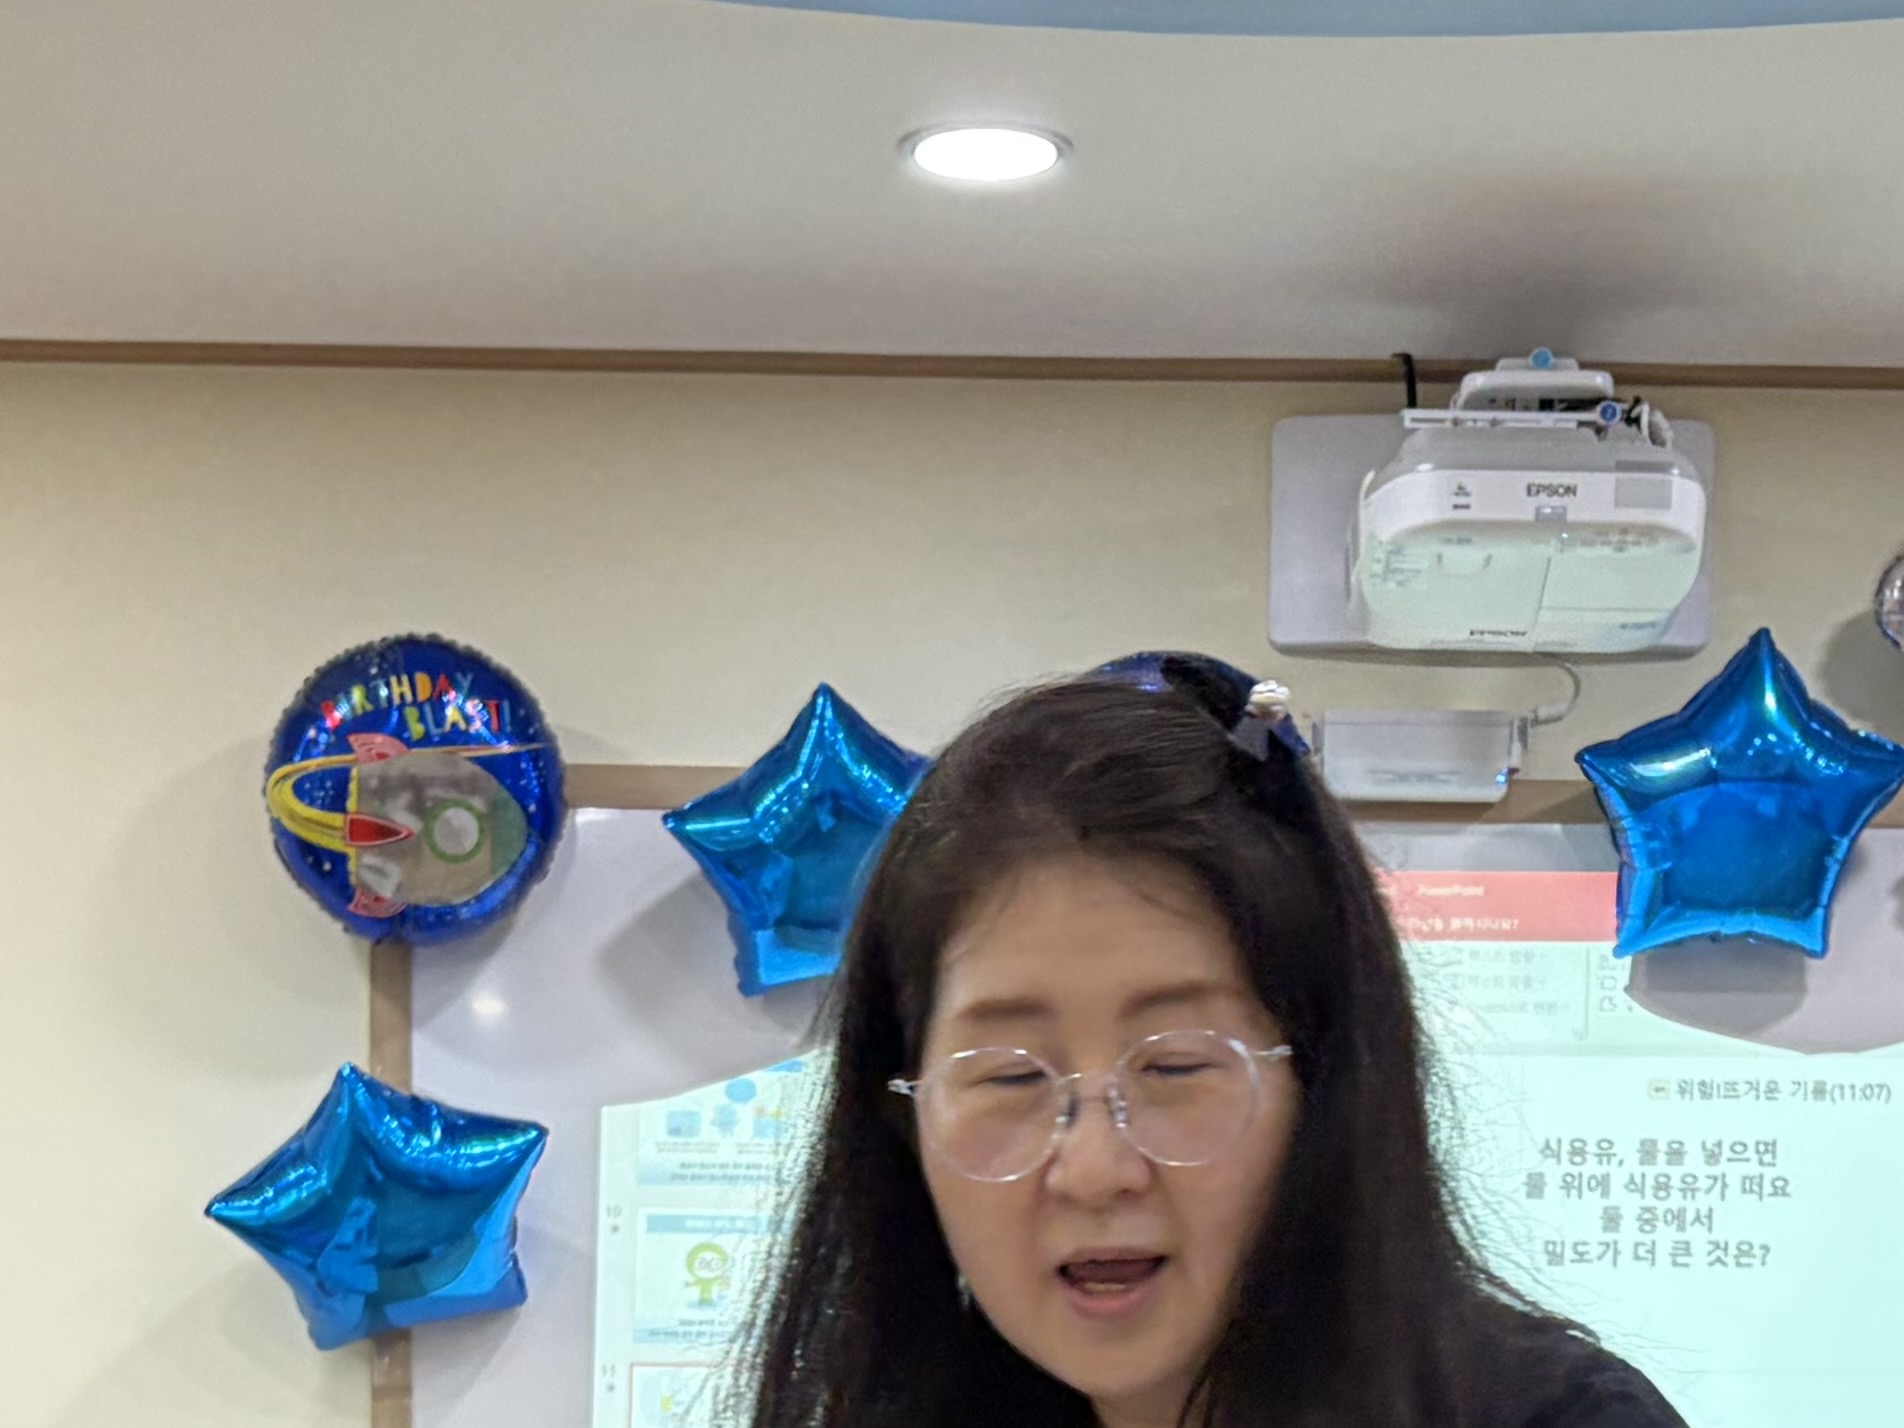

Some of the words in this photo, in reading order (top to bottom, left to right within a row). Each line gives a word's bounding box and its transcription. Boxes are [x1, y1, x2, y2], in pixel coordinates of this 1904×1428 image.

[1526, 483, 1578, 498] EPSON
[1539, 1138, 1625, 1168] 식용유,
[1636, 1139, 1688, 1166] 물을
[1702, 1139, 1779, 1167] 넣으면
[1522, 1172, 1547, 1200] 물
[1558, 1172, 1611, 1199] 위에
[1623, 1172, 1729, 1200] 식용유가
[1600, 1206, 1624, 1233] 둘
[1635, 1206, 1715, 1233] 중에서
[1543, 1240, 1622, 1268] 밀도가
[1633, 1240, 1658, 1268] 더
[1668, 1241, 1694, 1268] 큰
[1706, 1240, 1771, 1268] 것은?
